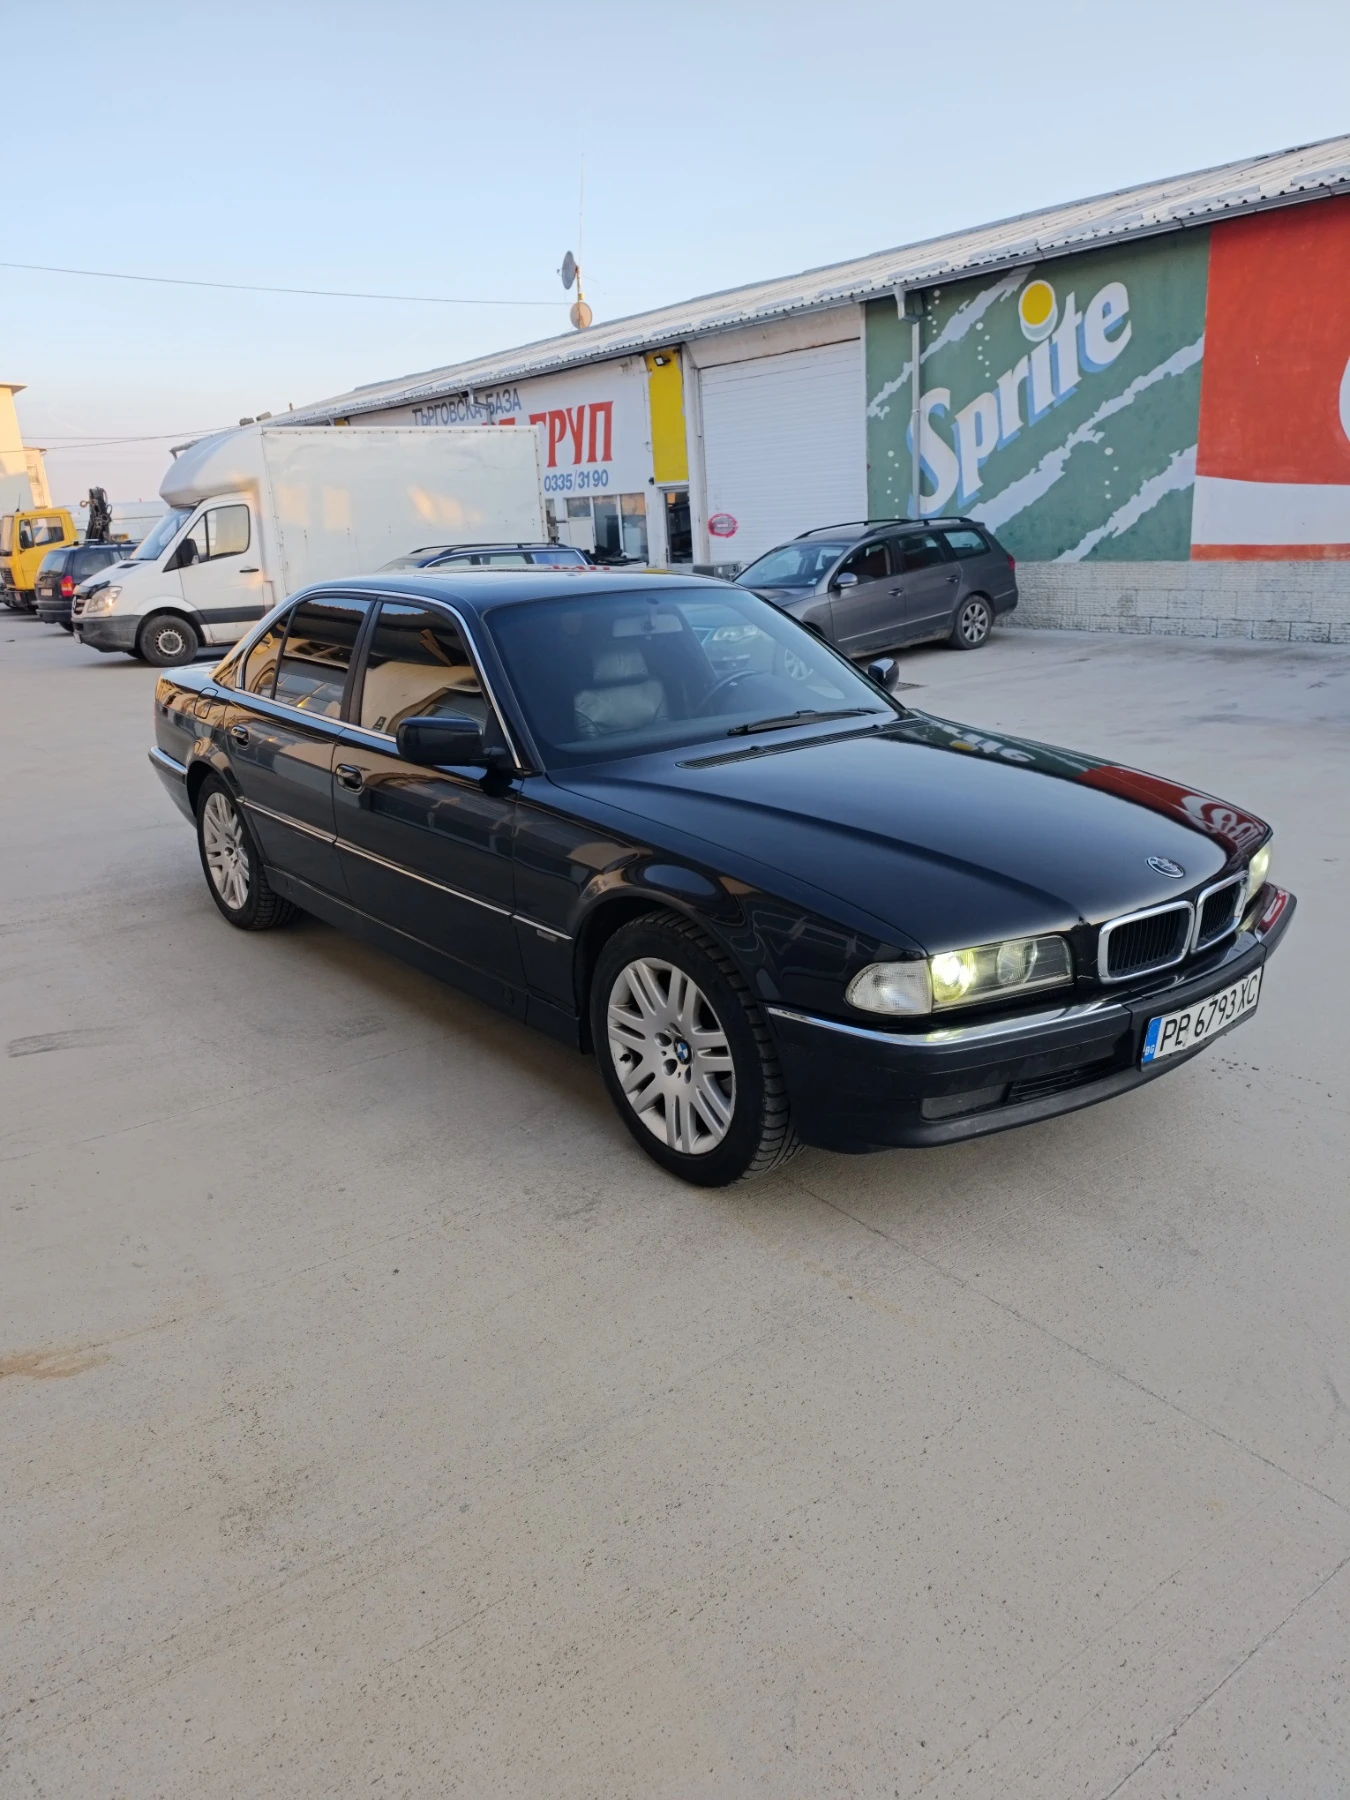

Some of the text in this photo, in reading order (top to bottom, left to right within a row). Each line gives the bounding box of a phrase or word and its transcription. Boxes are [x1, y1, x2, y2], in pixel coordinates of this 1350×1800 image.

[485, 388, 522, 416] БАЗА
[907, 280, 1133, 518] Sprite
[543, 469, 609, 492] 0335/3190
[1194, 989, 1237, 1038] 6793
[1237, 974, 1258, 1013] XC
[1144, 1044, 1156, 1056] BG
